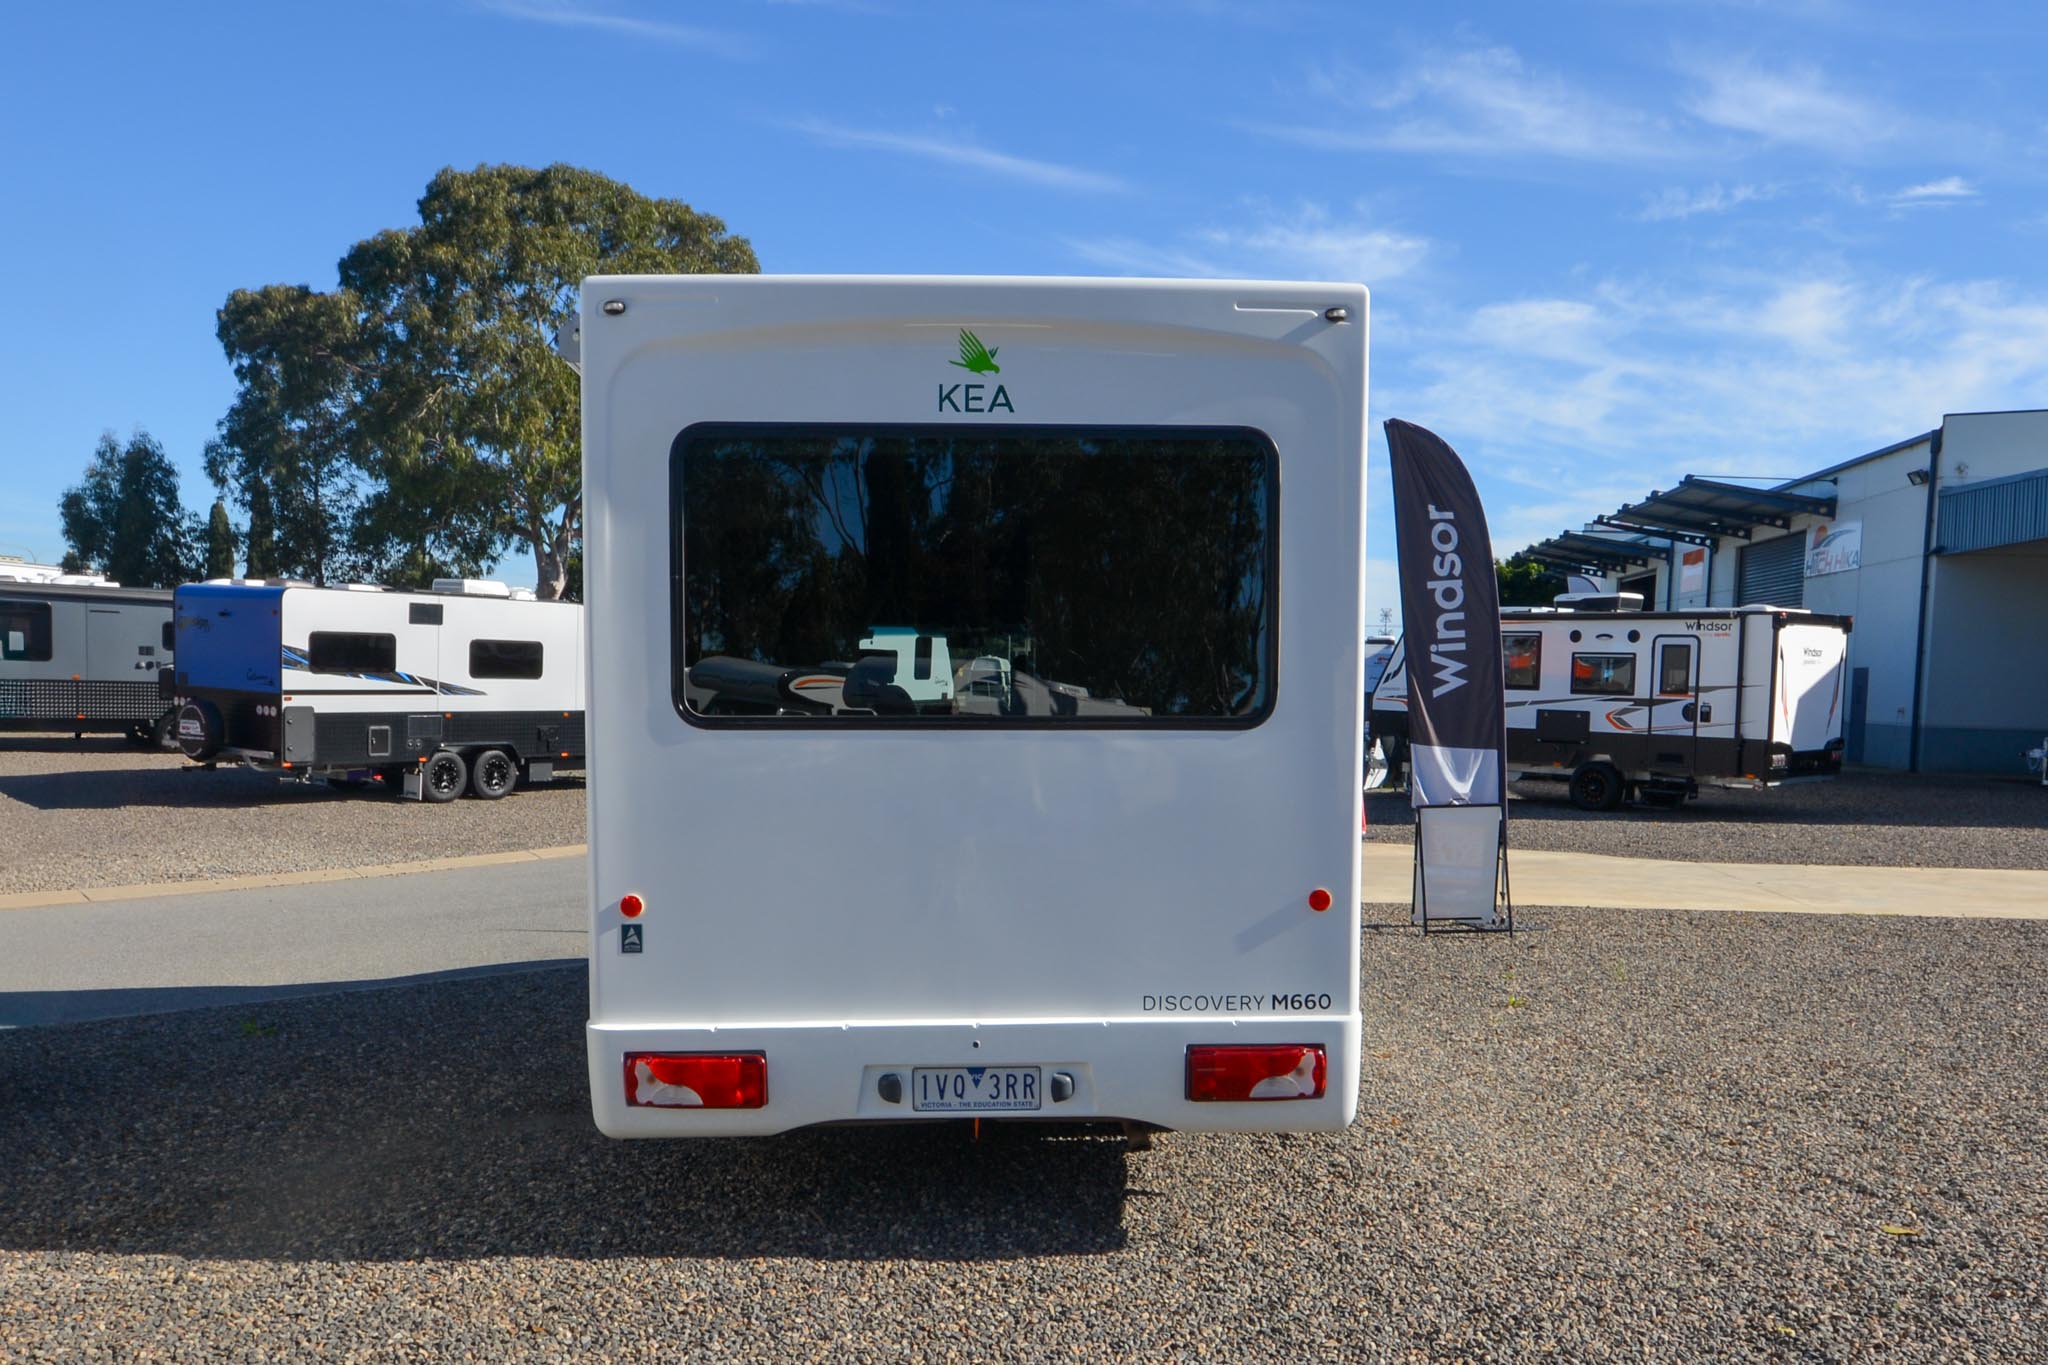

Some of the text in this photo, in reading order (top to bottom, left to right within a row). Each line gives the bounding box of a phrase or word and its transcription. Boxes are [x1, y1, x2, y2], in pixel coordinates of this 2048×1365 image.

[938, 383, 1015, 413] KEA
[1427, 504, 1469, 698] Windsor
[1685, 621, 1733, 632] Windsor
[1143, 993, 1332, 1012] DISCOVERY M660
[921, 1073, 1036, 1101] 1VQ 3RR
